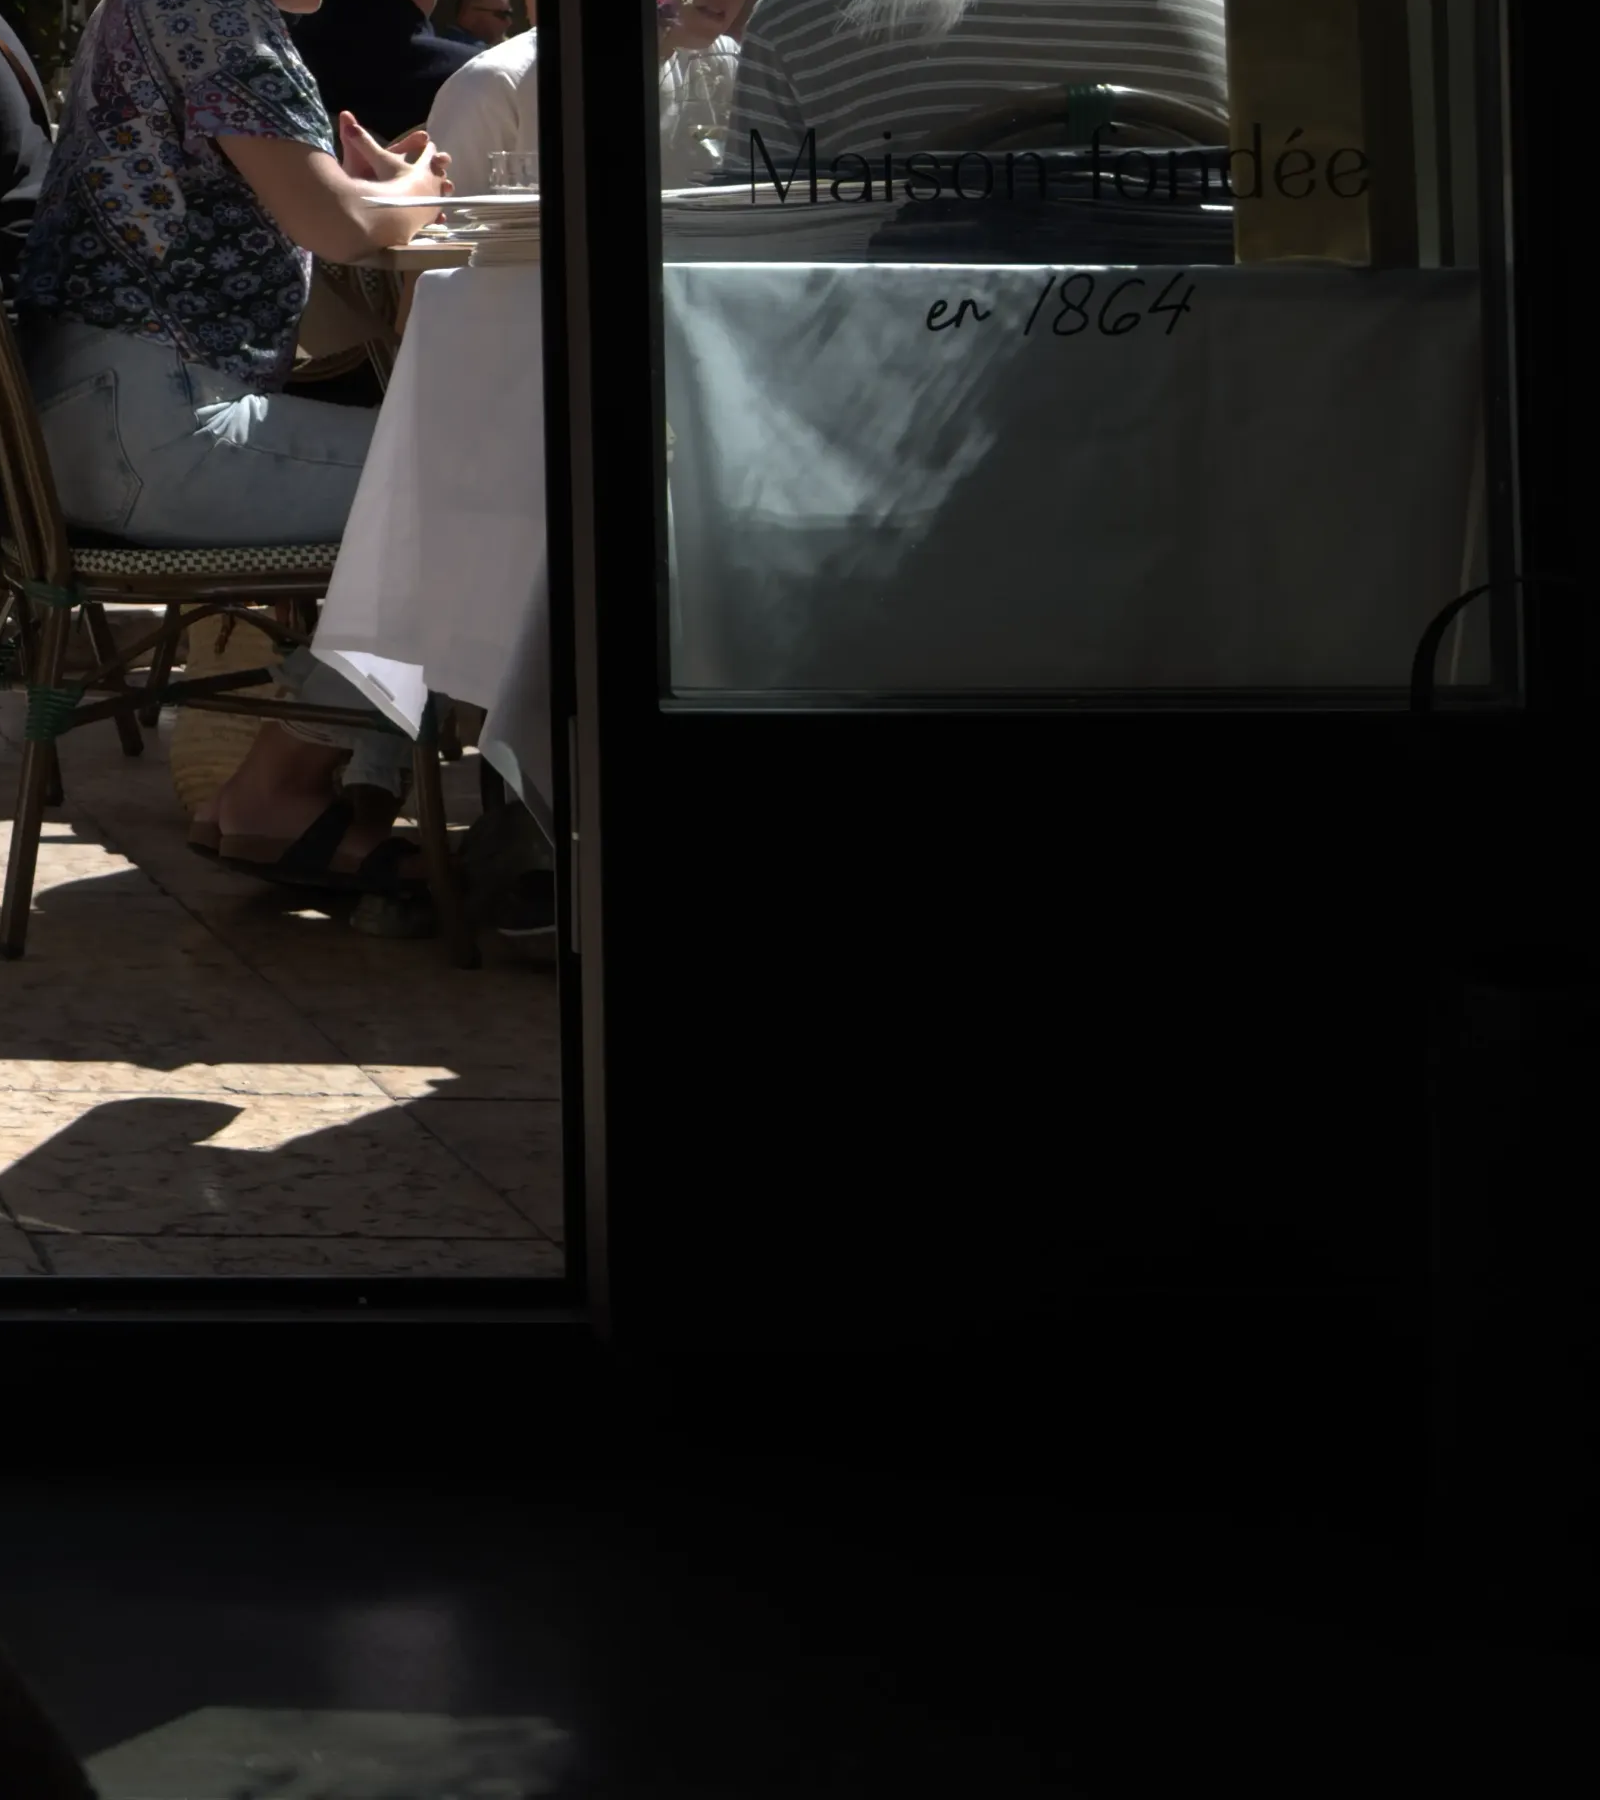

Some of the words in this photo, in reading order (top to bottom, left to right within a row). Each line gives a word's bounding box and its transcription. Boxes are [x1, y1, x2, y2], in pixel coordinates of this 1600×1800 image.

[749, 127, 1047, 205] Maison
[1090, 121, 1372, 202] fondée
[925, 295, 992, 332] en
[1023, 271, 1197, 338] 1864
